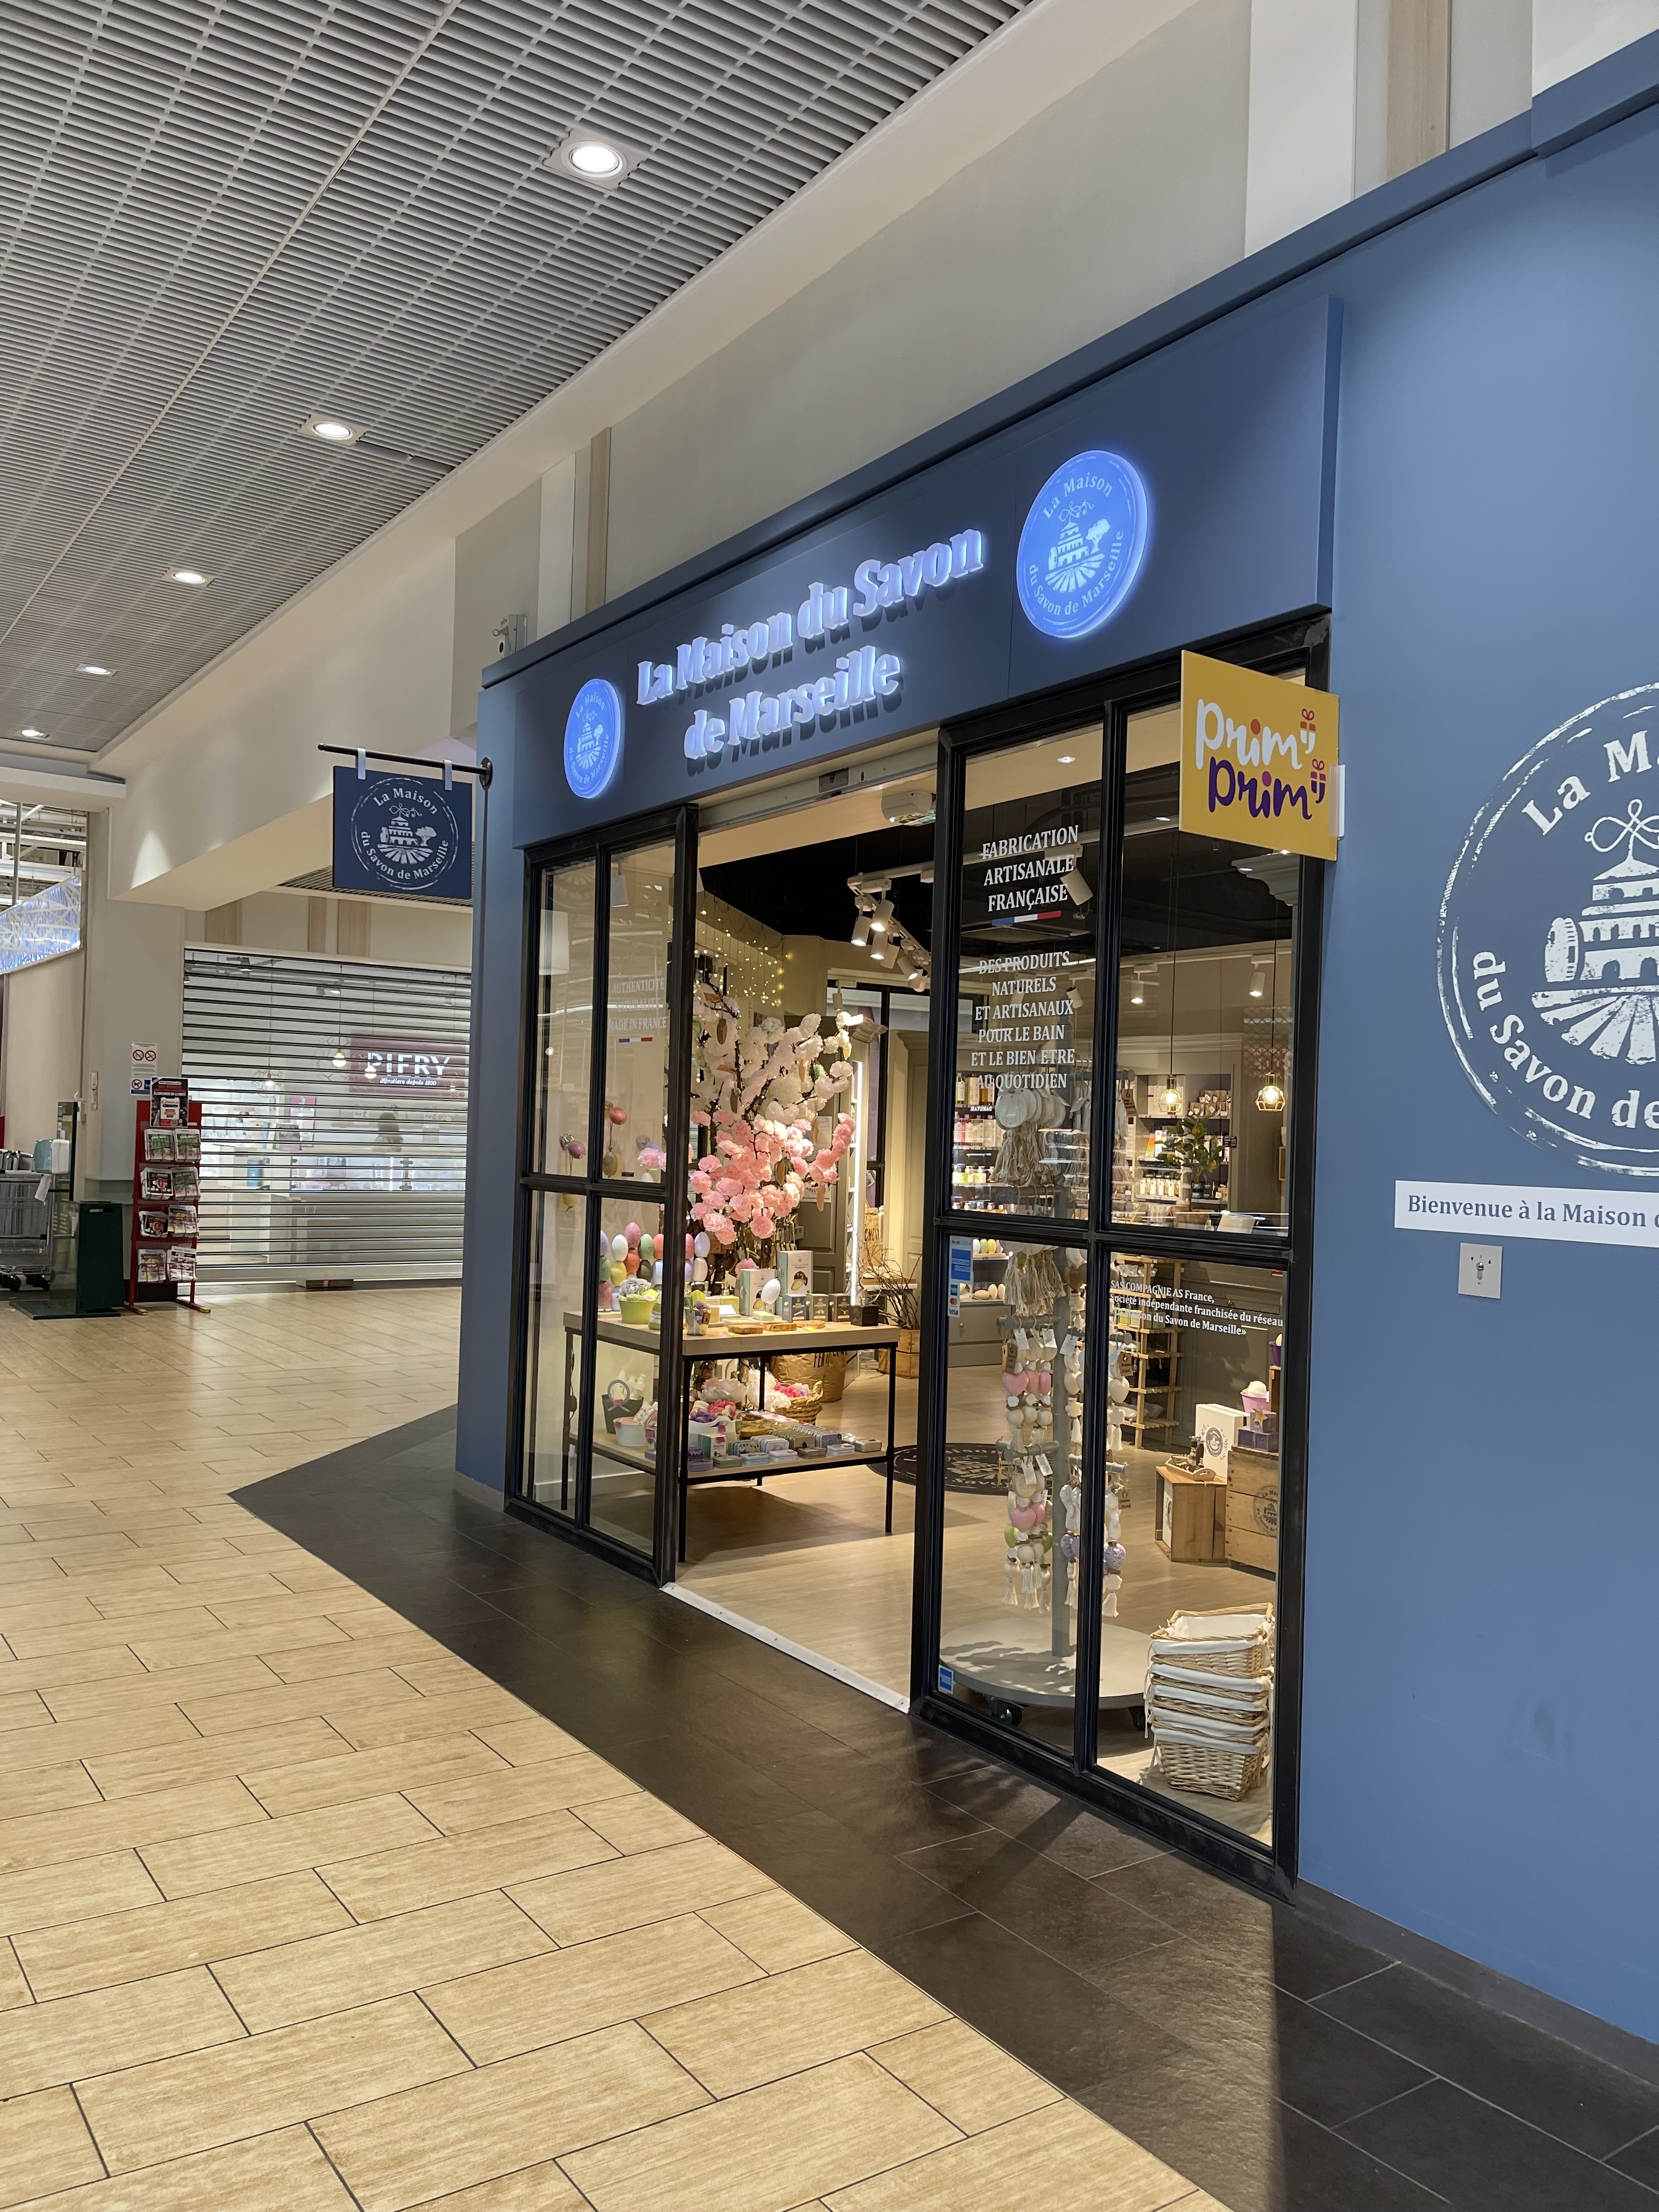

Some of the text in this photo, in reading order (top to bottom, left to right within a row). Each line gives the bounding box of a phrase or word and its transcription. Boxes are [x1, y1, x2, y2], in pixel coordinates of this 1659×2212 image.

[1043, 472, 1113, 519] La Maison
[1029, 530, 1124, 616] du Savon de Marseille
[636, 528, 984, 706] La Maison du Savon
[575, 692, 605, 719] La Maison
[684, 645, 900, 759] de Marseille
[571, 762, 583, 783] Savon
[583, 774, 590, 784] de
[591, 733, 609, 781] Marseille
[1522, 730, 1659, 836] La M
[373, 788, 438, 815] La Maison
[360, 831, 449, 879] du Savon de Marseille
[982, 825, 1079, 859] FABRICATION
[984, 854, 1074, 886] ARTISANALE
[988, 883, 1068, 911] FRANÇAISE
[979, 951, 1069, 974] DES PRODUITS
[612, 978, 664, 994] AUTHENTICITE
[992, 977, 1056, 996] NATURELS
[1473, 950, 1507, 1011] du
[607, 1017, 667, 1031] MADE IN FRANCE
[975, 1000, 1073, 1020] ET ARTISANAUX
[979, 1025, 1064, 1043] POUR LE BAIN
[971, 1049, 1075, 1066] ET LE BIEN ETRE
[1489, 1014, 1596, 1120] Savon
[979, 1074, 1067, 1092] AU QUOTIDIEN
[1408, 1195, 1513, 1218] Bienvenue
[1519, 1200, 1530, 1219] à
[1537, 1201, 1556, 1221] la
[1563, 1204, 1646, 1227] Maison
[1110, 1280, 1215, 1304] SAS COMPAGNIE AS France,
[1110, 1293, 1137, 1305] Société
[1138, 1297, 1193, 1315] indépendante
[1194, 1305, 1238, 1321] franchisée
[1240, 1312, 1252, 1322] du
[1253, 1314, 1283, 1327] réseau
[1153, 1312, 1164, 1323] du
[1165, 1314, 1188, 1327] Savon
[1190, 1318, 1201, 1329] de
[1202, 1321, 1246, 1335] Marseille»
